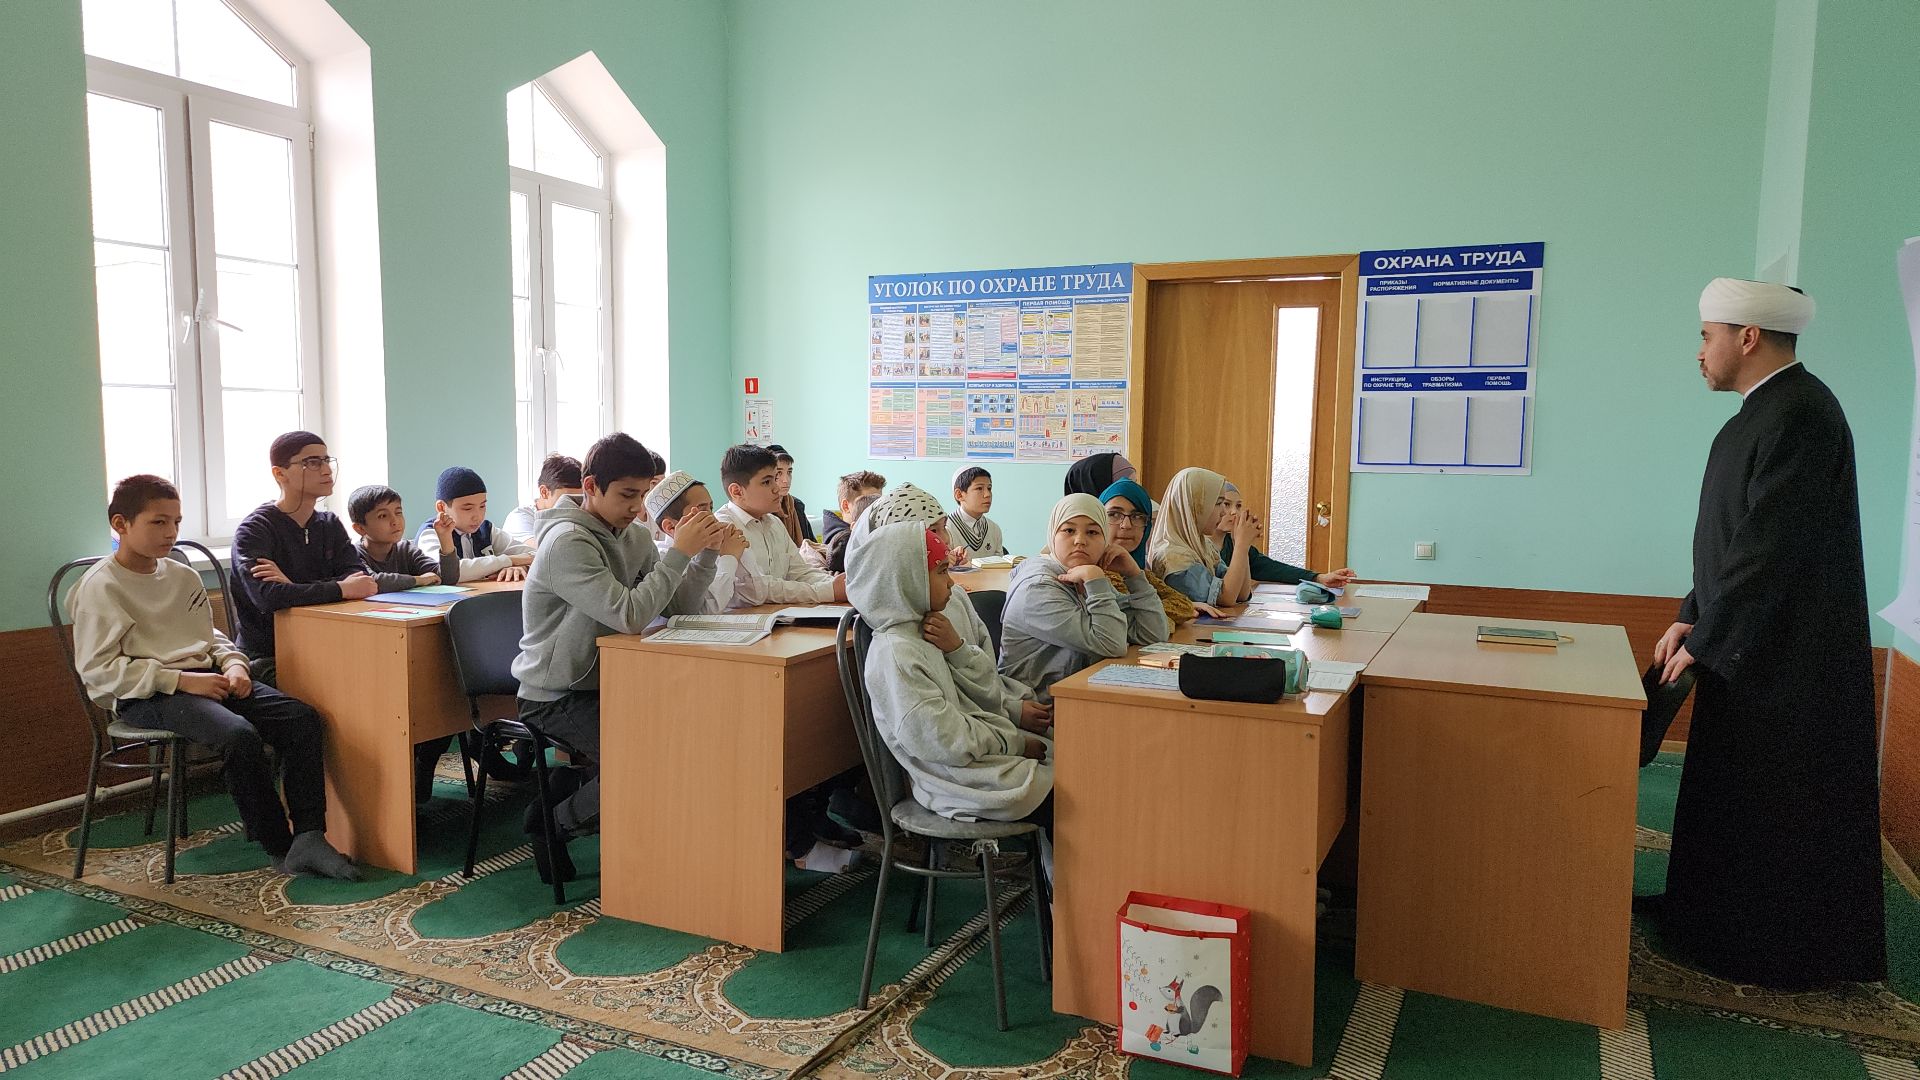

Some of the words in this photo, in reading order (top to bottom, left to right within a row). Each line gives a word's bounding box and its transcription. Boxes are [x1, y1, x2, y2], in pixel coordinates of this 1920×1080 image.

[1373, 254, 1455, 270] ОХРАНА
[1459, 250, 1527, 267] ТРУДА
[873, 279, 945, 299] УГОЛОК
[948, 277, 976, 297] ПО
[979, 275, 1056, 294] ОХРАНЕ
[1060, 271, 1126, 291] ТРУДА
[1432, 279, 1479, 287] НОРМАТИВНЫЕ
[1479, 278, 1520, 286] ДОКУМЕНТЫ
[1044, 299, 1071, 307] ПОМОЩЬ
